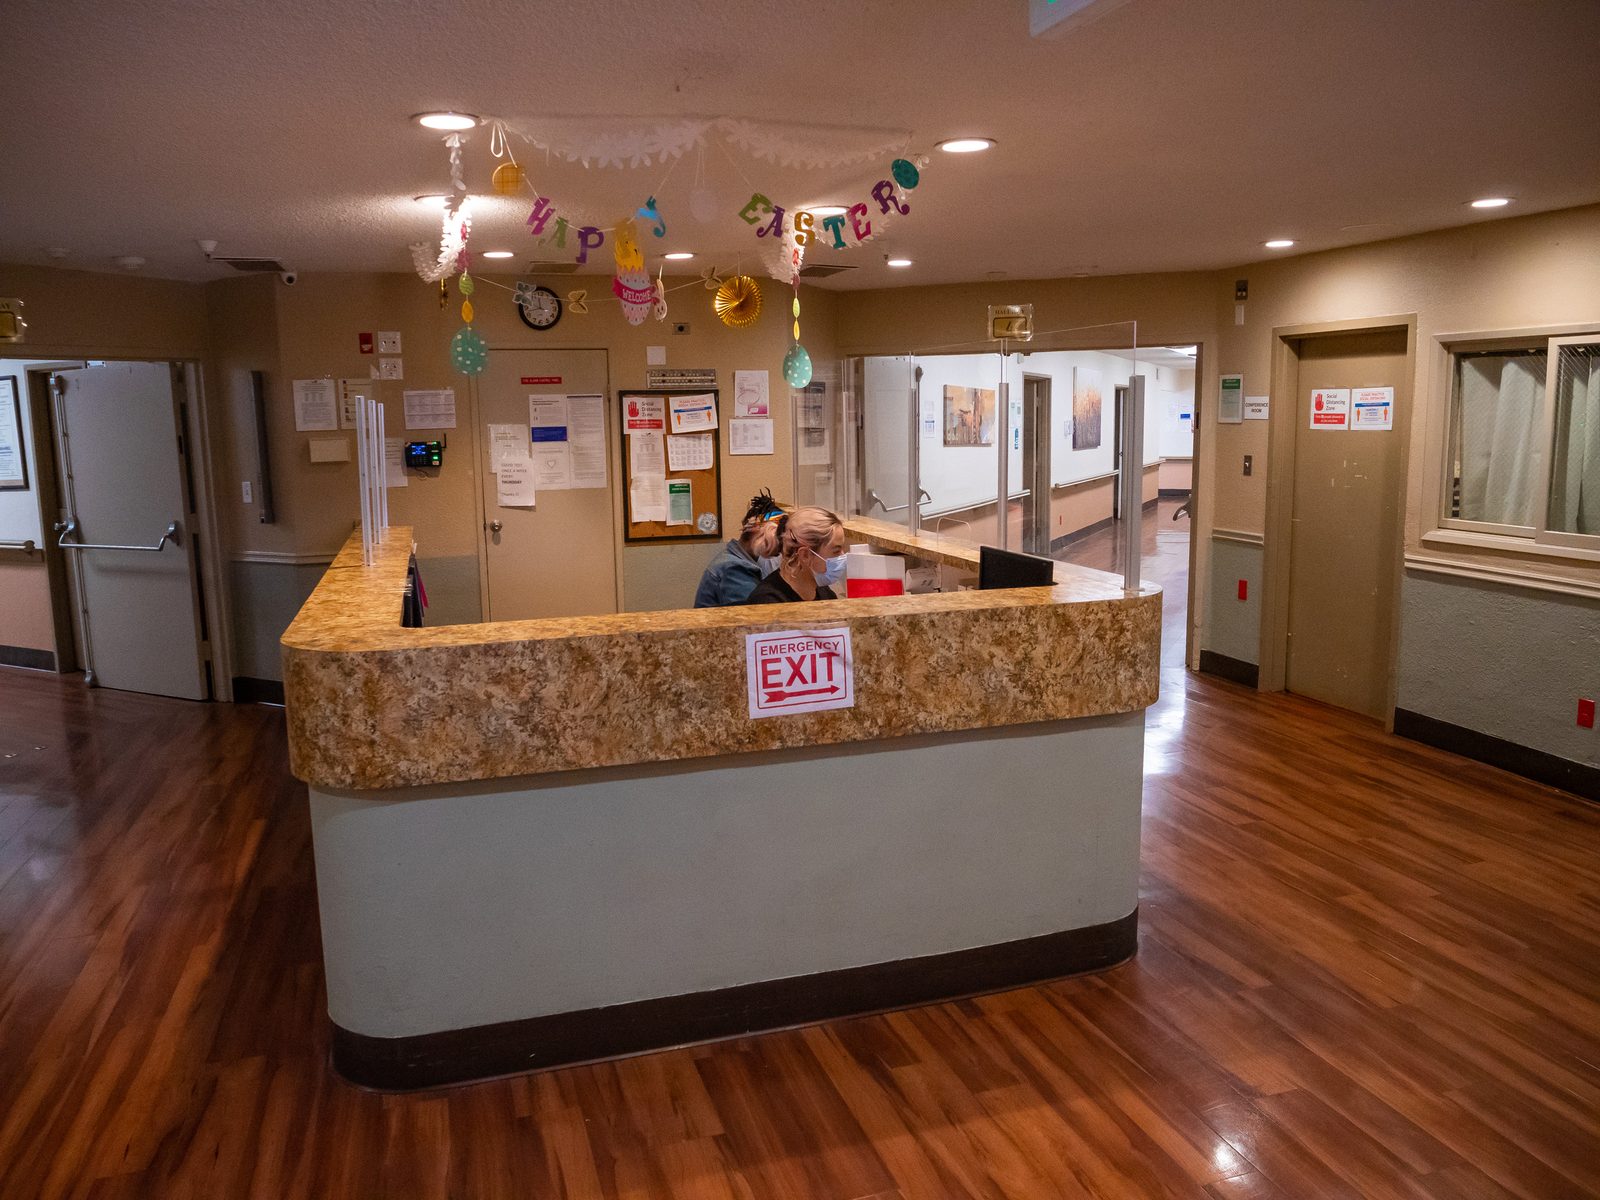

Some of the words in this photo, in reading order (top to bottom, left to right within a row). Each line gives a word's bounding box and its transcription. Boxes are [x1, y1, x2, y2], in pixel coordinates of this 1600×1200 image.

[738, 180, 910, 249] EASTER
[622, 288, 651, 302] WELCOME
[761, 641, 840, 655] EMERGENCY
[761, 652, 840, 689] EXIT
